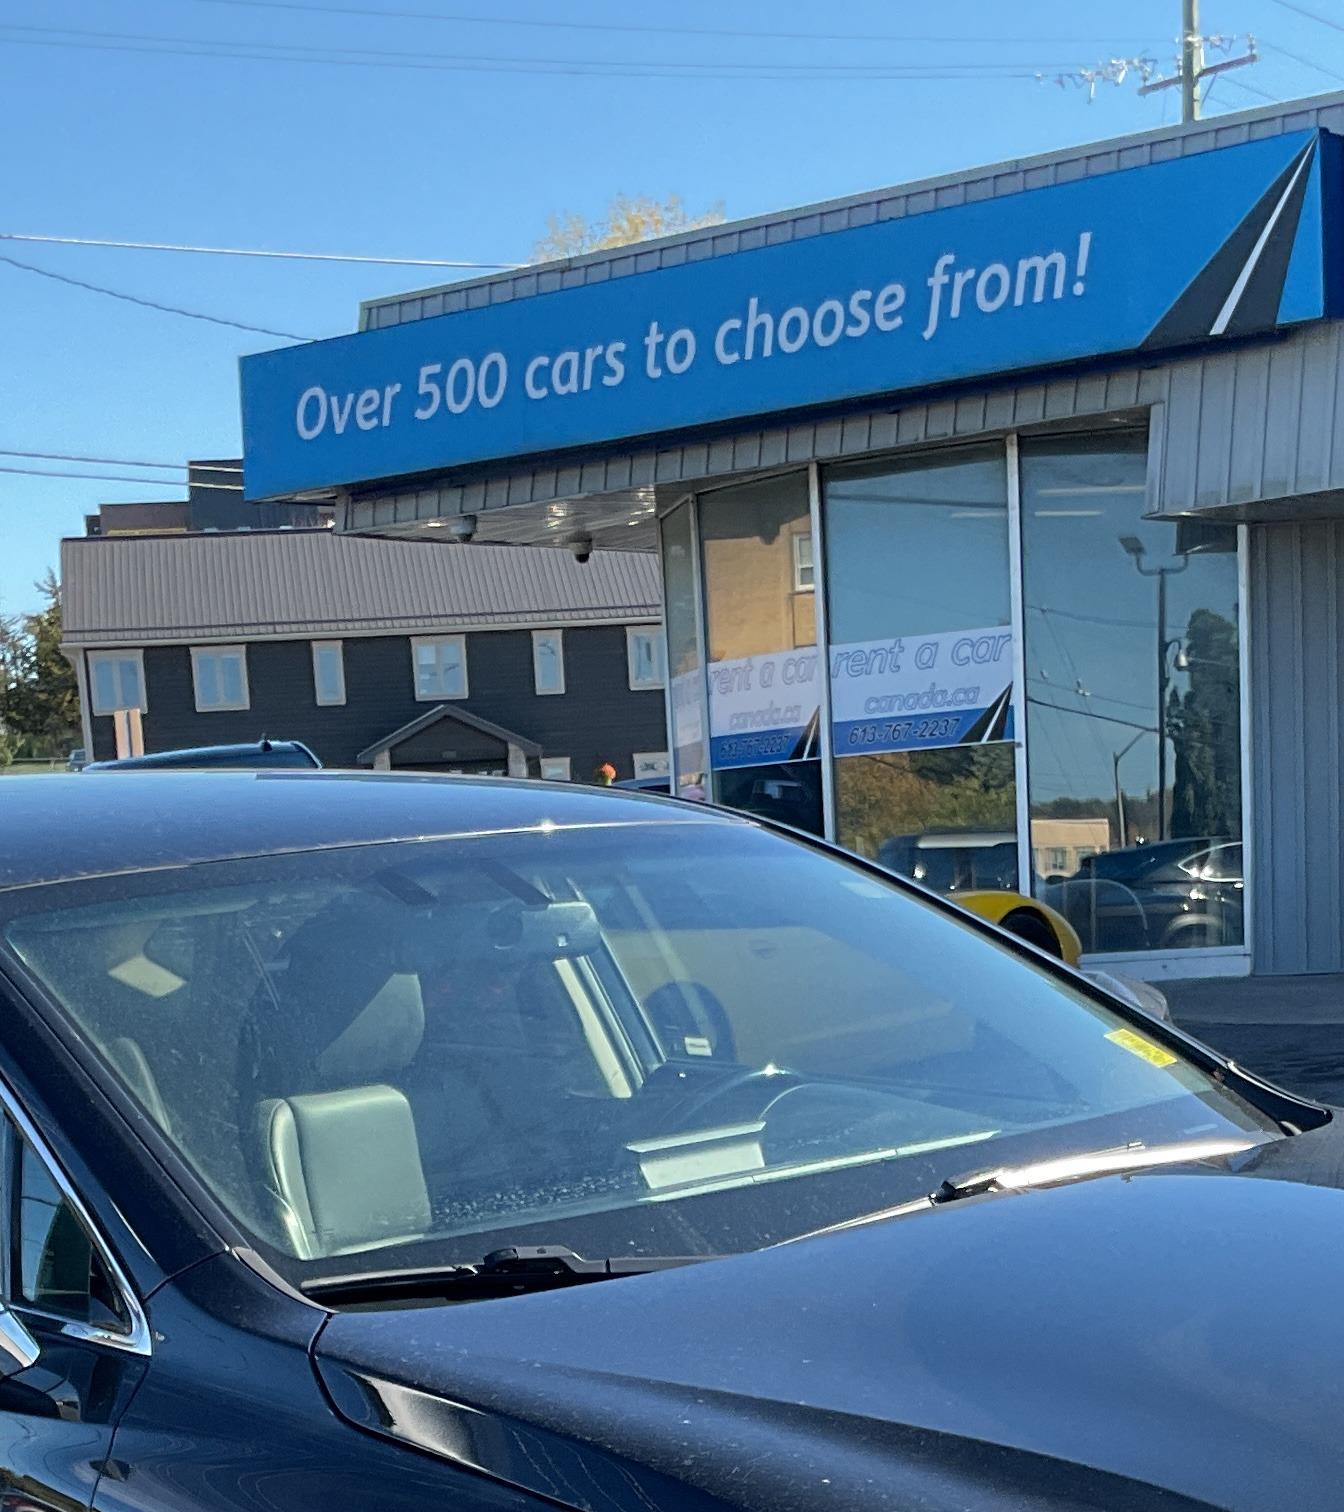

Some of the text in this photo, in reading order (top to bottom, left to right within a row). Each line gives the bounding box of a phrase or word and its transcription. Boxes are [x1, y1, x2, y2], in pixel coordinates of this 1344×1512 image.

[296, 231, 1093, 440] Over 500 cars to choose from!
[831, 632, 1013, 679] rent a car
[759, 661, 775, 689] a
[864, 681, 980, 715] canada.ca
[848, 717, 961, 745] 613-767-2237
